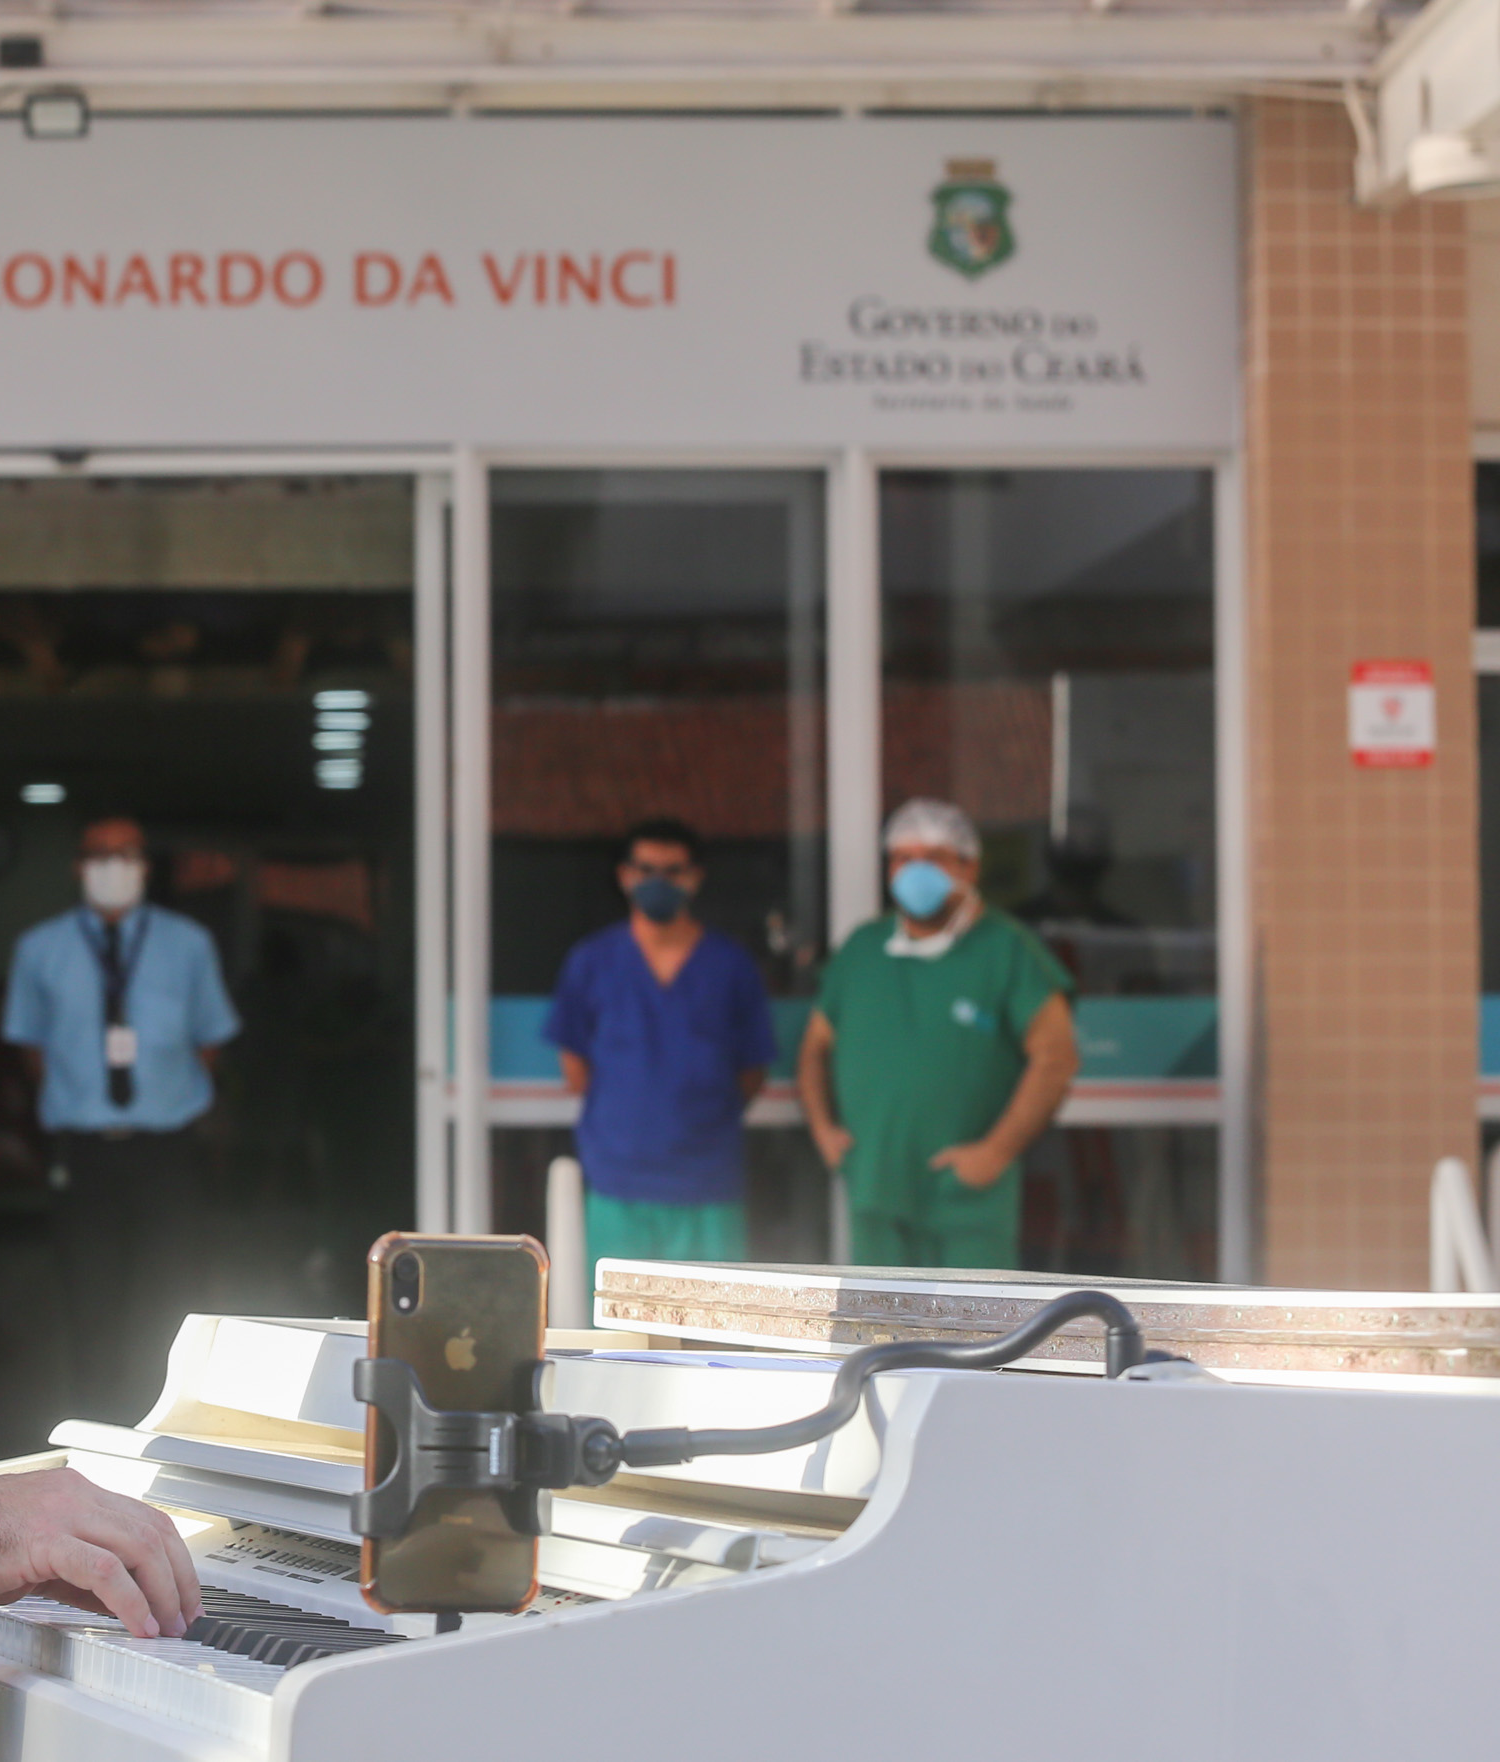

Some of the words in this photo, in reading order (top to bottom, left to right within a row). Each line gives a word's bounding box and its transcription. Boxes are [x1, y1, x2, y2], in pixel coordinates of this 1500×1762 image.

[352, 250, 456, 309] DA
[481, 249, 678, 308] VINCI
[847, 294, 1044, 339] GOVERNO
[799, 340, 952, 384] ESTADO
